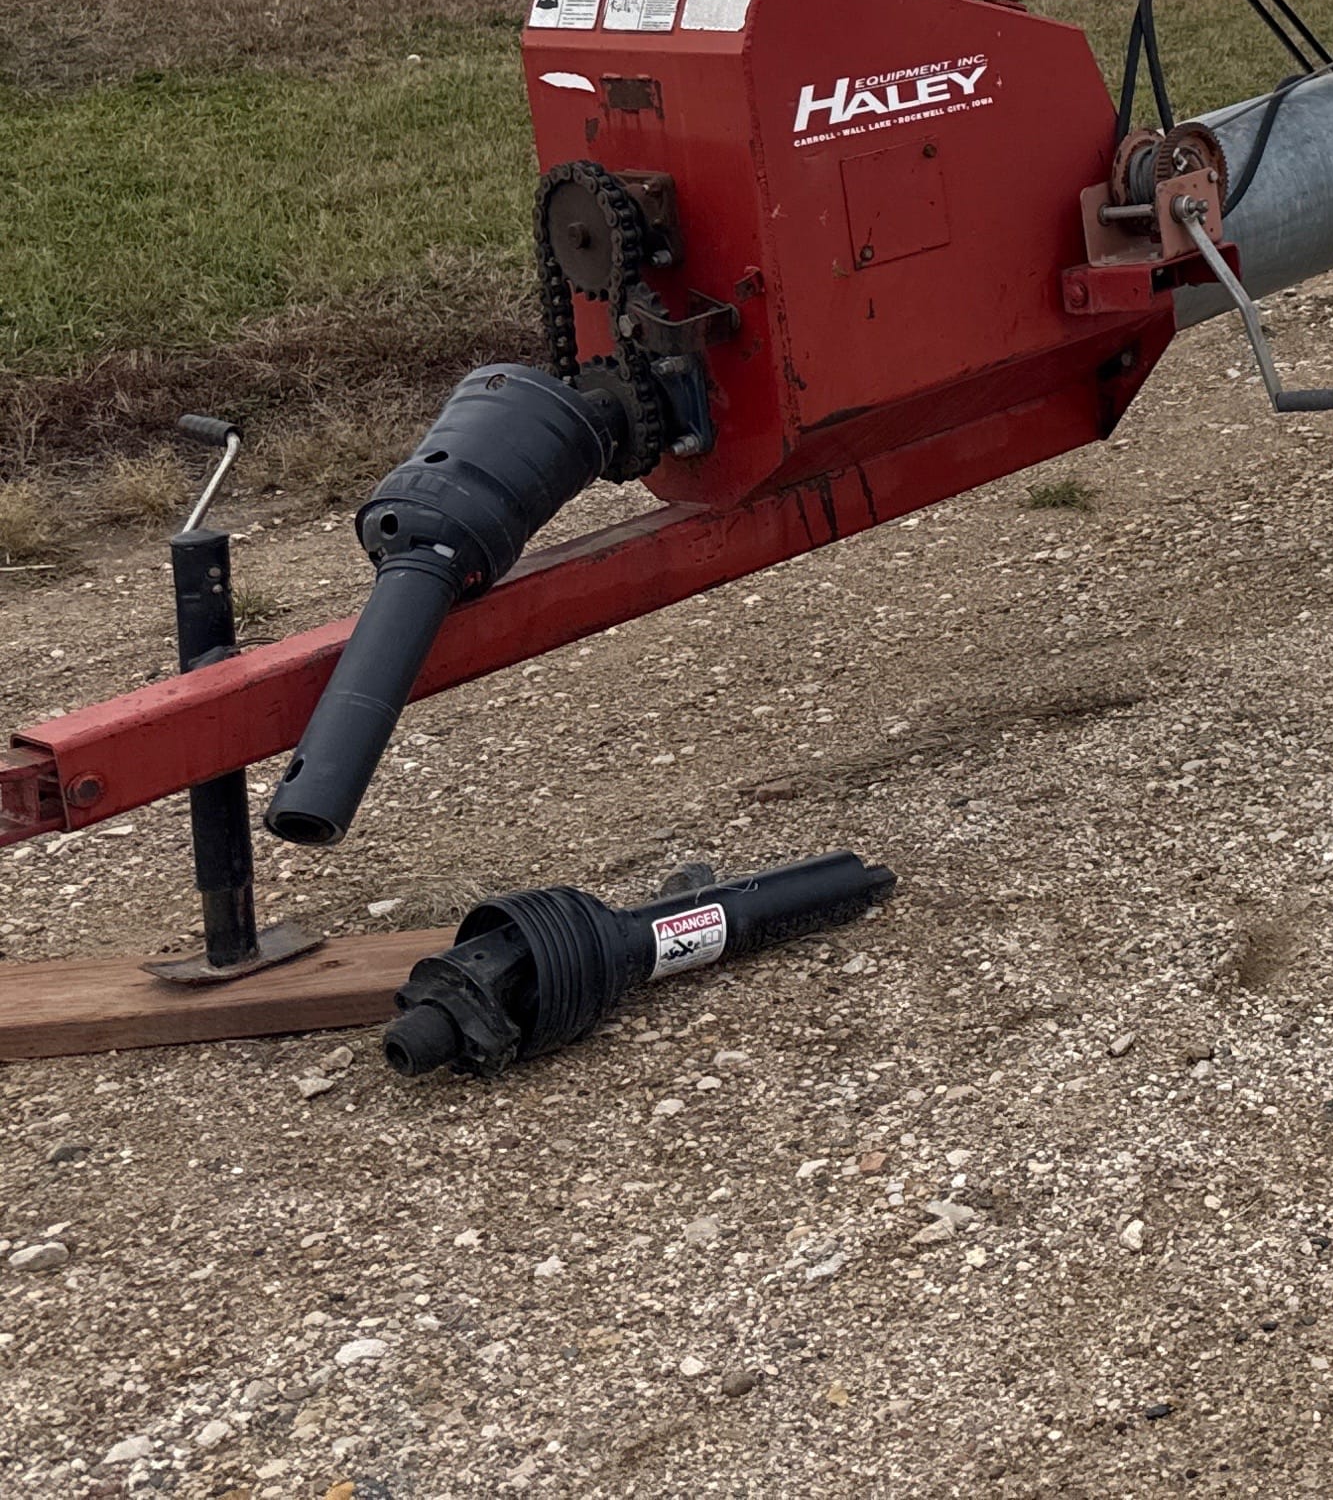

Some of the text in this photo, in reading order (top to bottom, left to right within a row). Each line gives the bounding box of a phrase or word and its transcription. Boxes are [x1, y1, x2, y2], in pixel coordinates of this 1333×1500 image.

[855, 54, 988, 89] EQUIPMENT INC.
[793, 65, 988, 133] HALEY
[793, 97, 993, 148] CARROLL WALL LAKE ROCKWELL CITY, IOWA
[672, 910, 721, 935] DANGER
